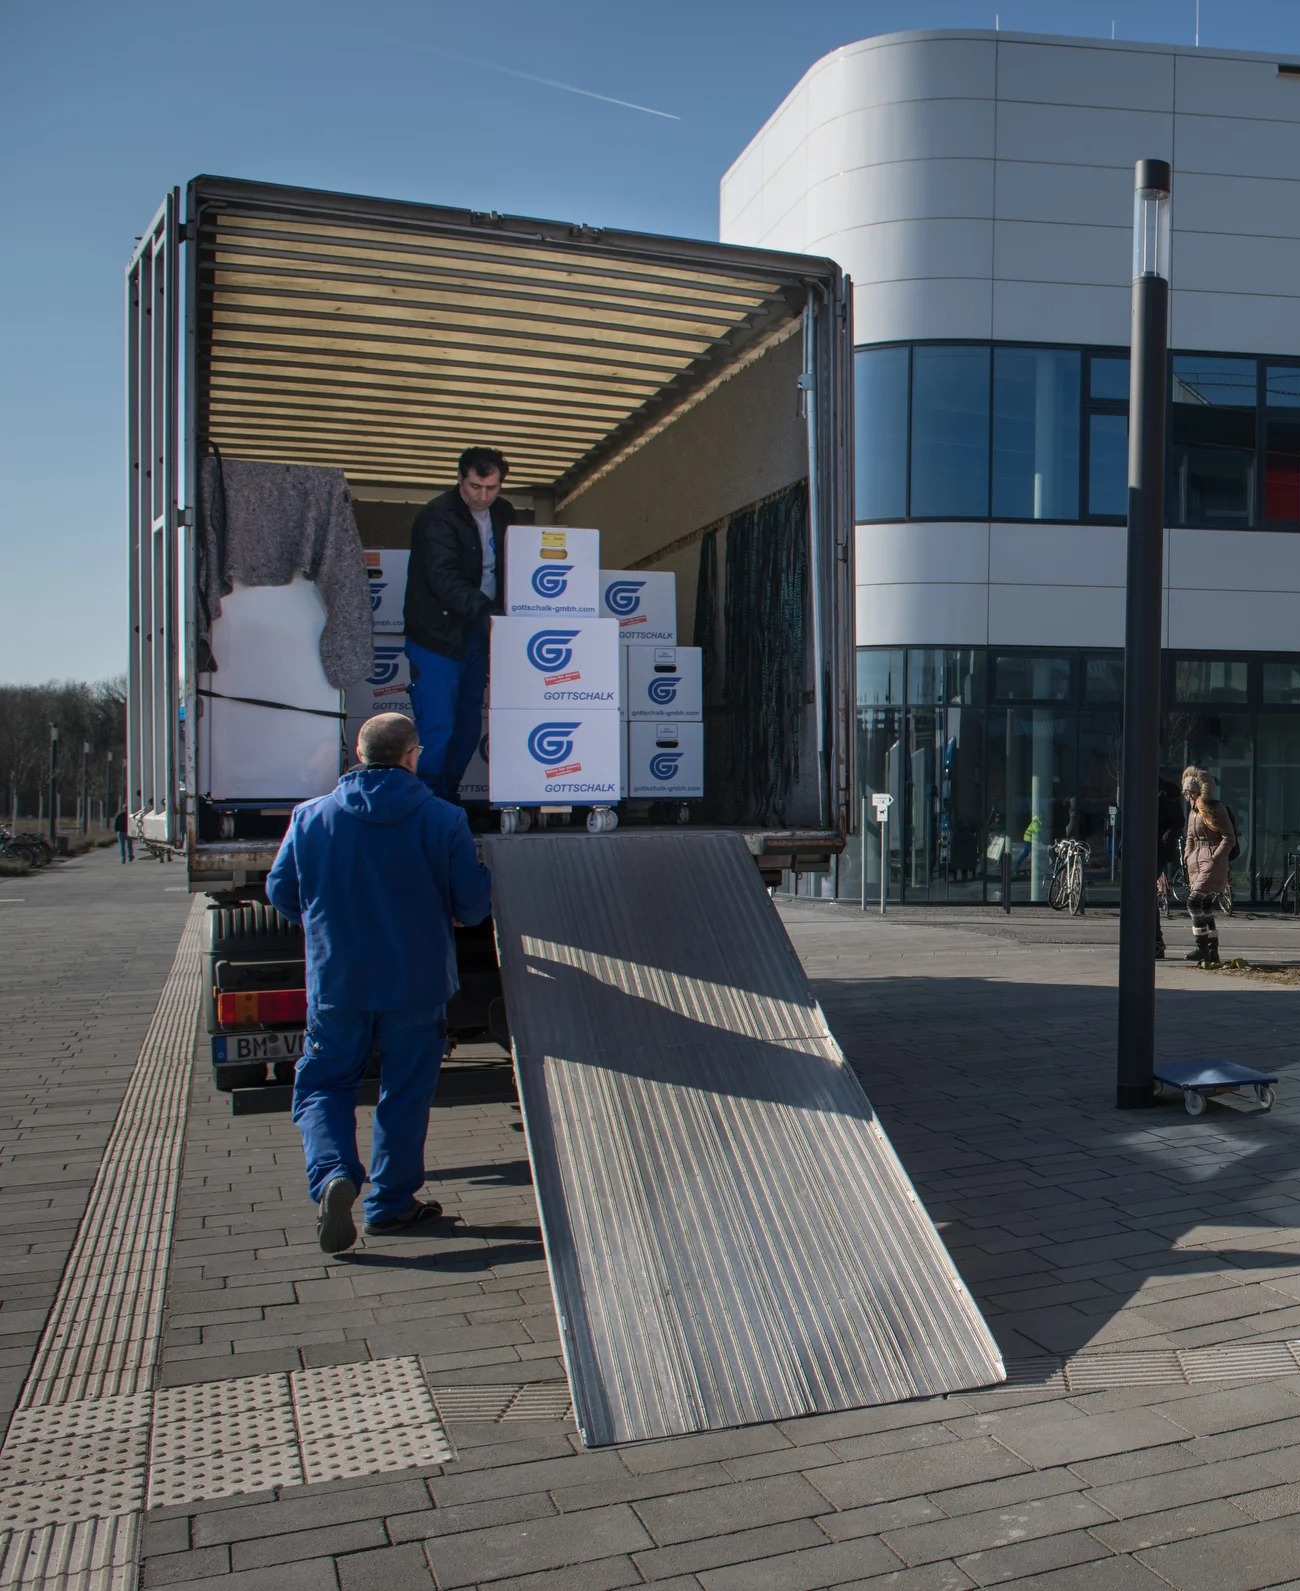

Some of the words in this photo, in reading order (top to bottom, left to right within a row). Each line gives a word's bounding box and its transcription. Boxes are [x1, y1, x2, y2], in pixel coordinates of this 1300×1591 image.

[511, 604, 596, 613] gottschalk-gmbh.com
[619, 631, 673, 640] GOTTSCHALK
[544, 691, 614, 701] GOTTSCHALK
[545, 783, 615, 793] GOTTSCHALK
[238, 1037, 268, 1058] BM
